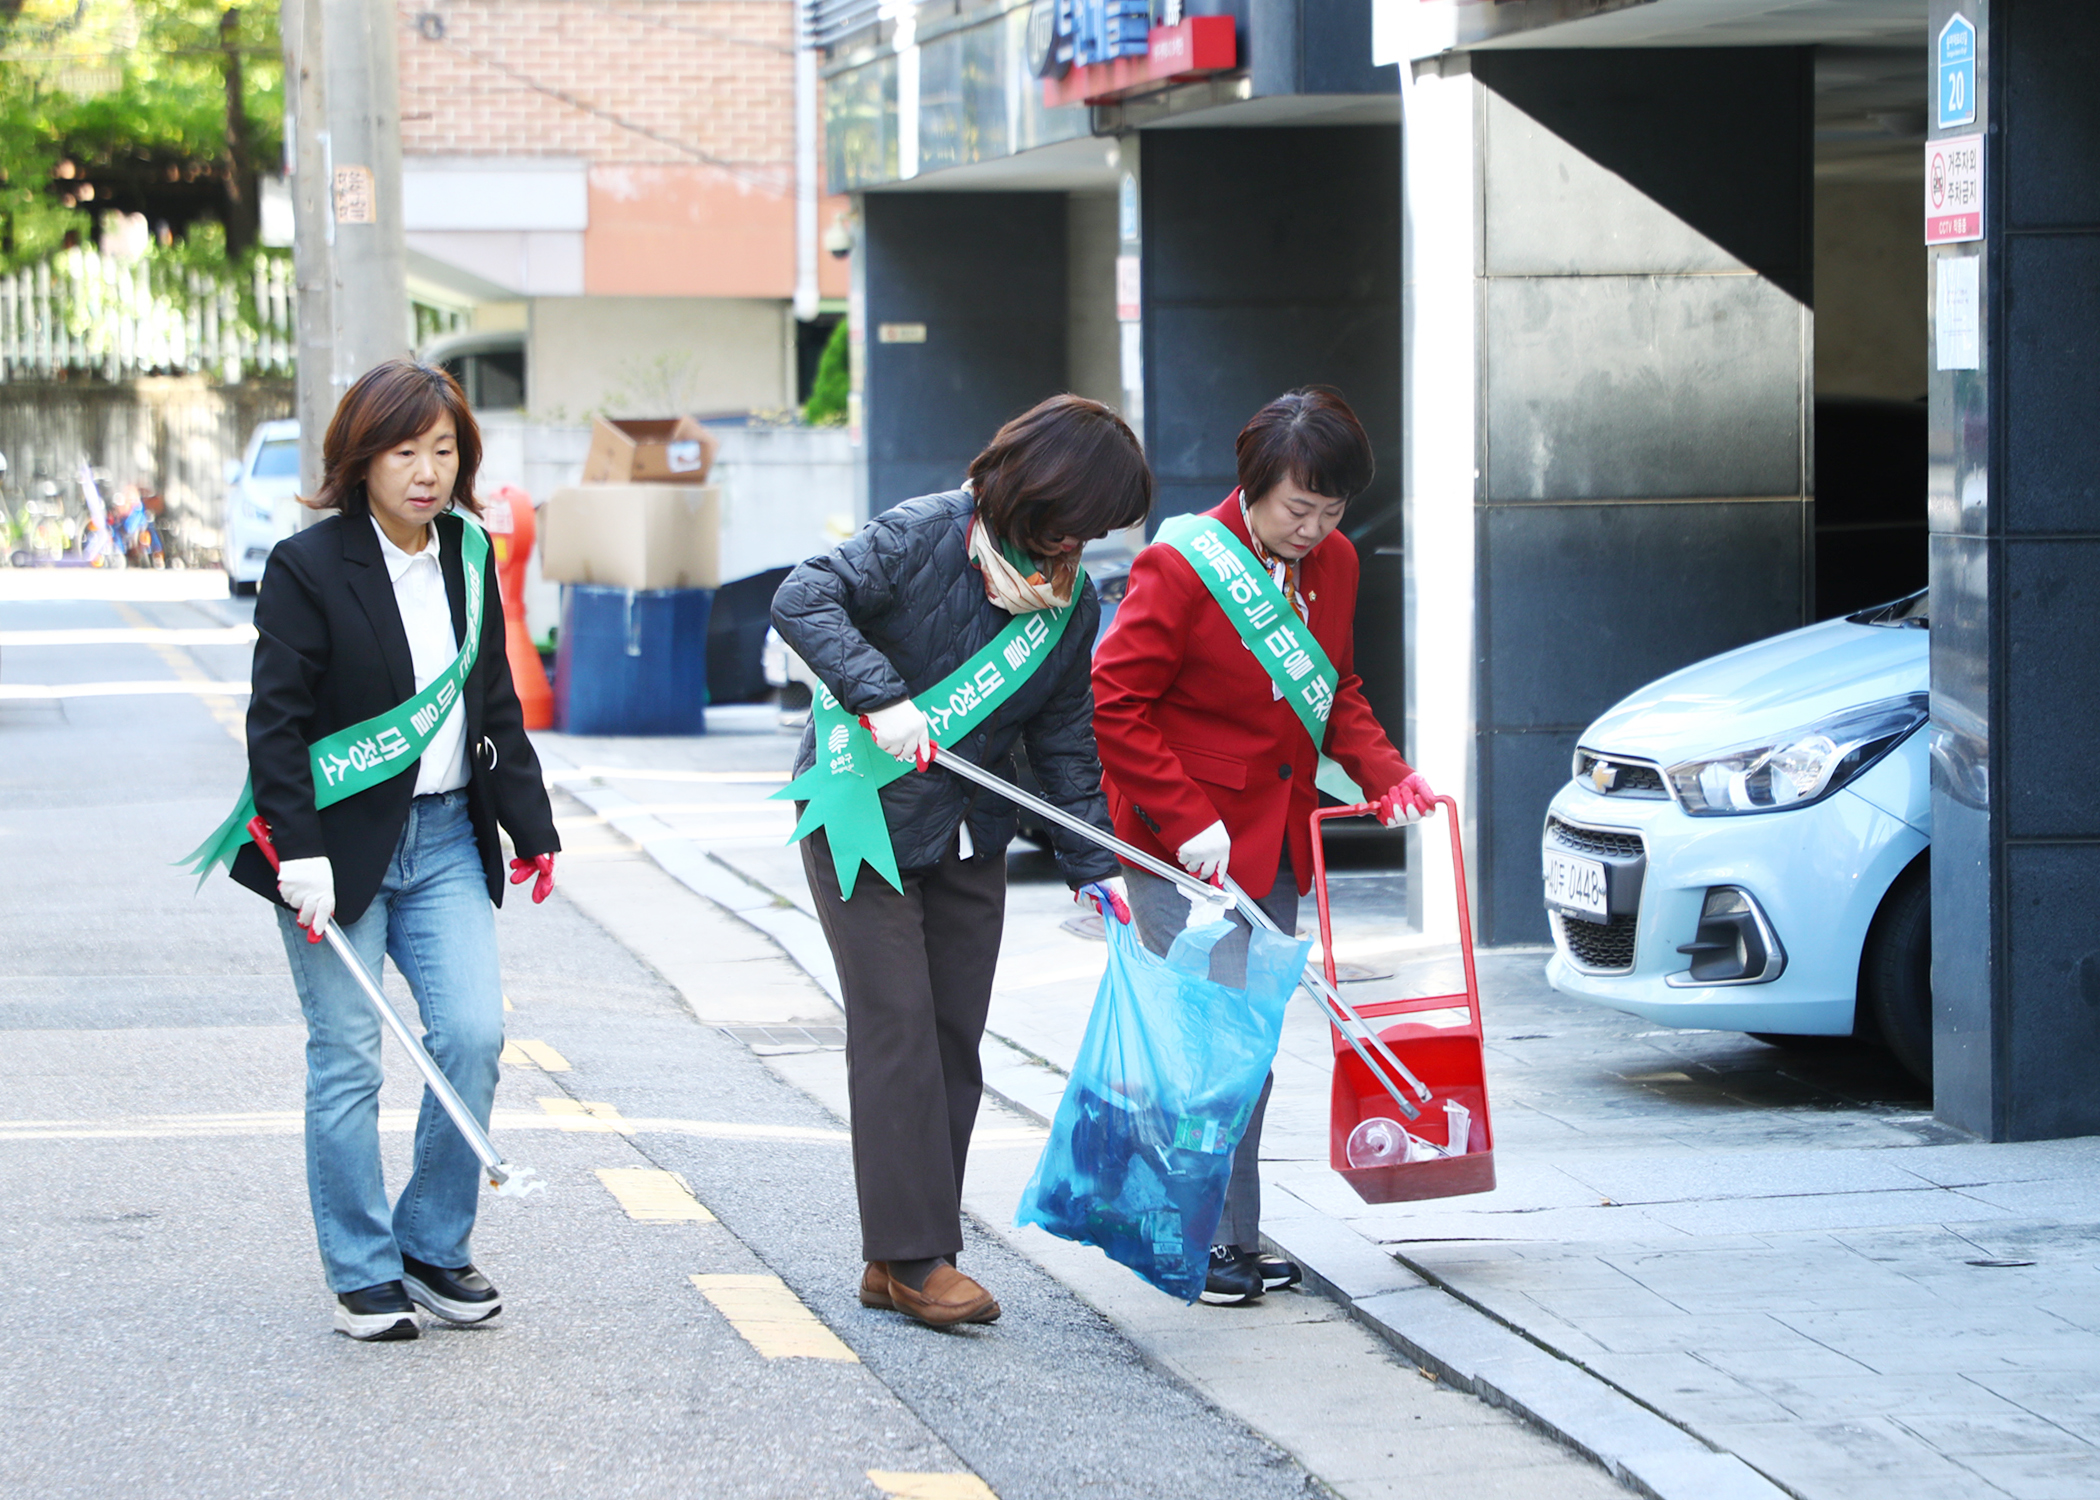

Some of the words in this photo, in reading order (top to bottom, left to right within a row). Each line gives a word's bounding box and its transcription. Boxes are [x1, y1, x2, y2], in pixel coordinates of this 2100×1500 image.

[1948, 70, 1965, 112] 20
[1948, 148, 1977, 176] 거주자외
[1948, 179, 1977, 206] 주차금지
[1938, 221, 1953, 235] CCTV
[1190, 529, 1278, 631] 함께하는
[1264, 624, 1315, 682] 마을
[1003, 613, 1050, 672] 마을
[410, 679, 457, 738] 마을
[923, 661, 1006, 737] 대청소
[318, 726, 411, 787] 대청소
[829, 752, 853, 770] 송파구
[1568, 864, 1599, 906] 0448
